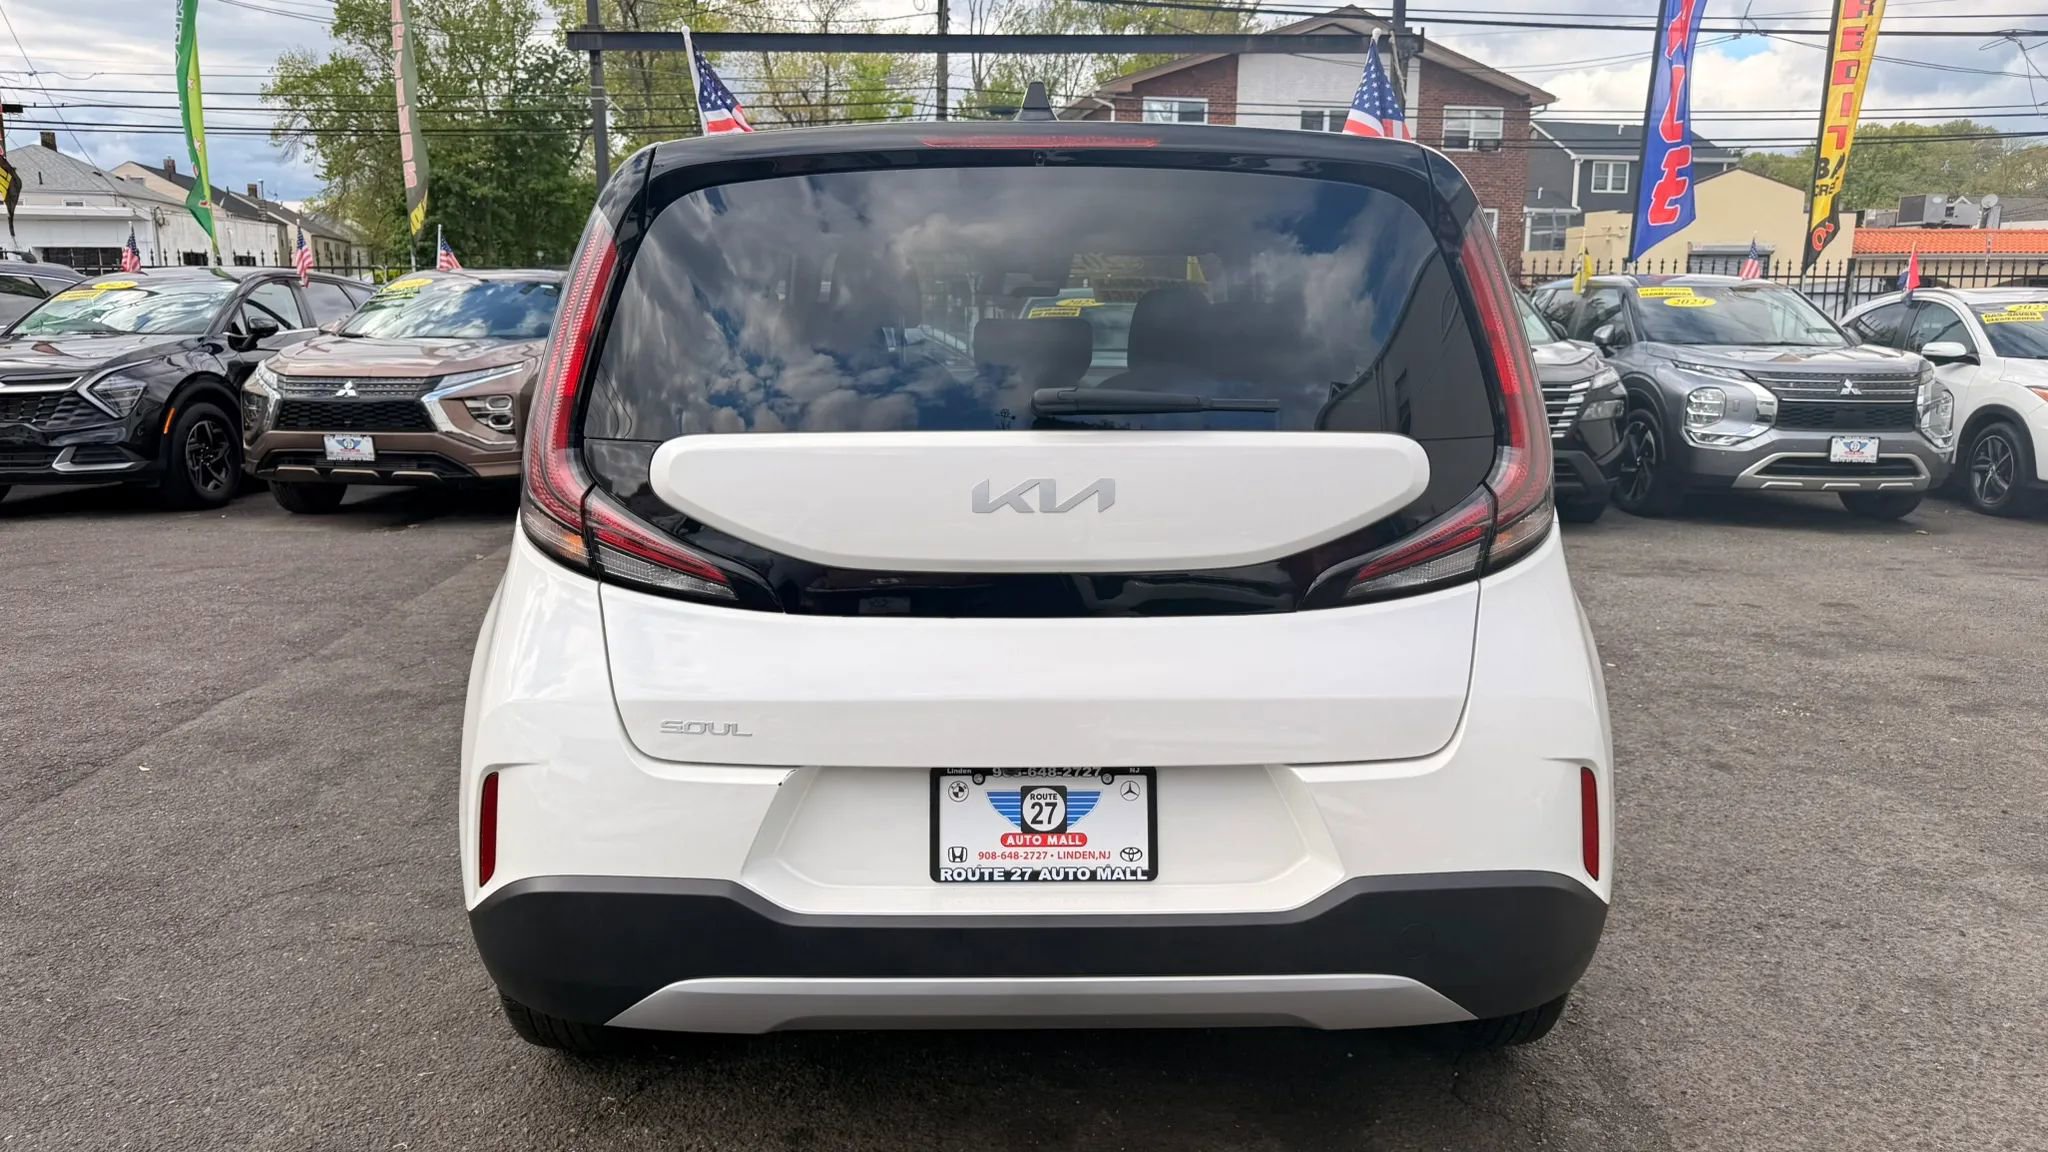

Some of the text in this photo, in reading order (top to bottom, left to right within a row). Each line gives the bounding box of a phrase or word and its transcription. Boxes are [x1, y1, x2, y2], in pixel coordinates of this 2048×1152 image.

[971, 478, 1116, 513] KIA
[660, 720, 753, 737] SOUL
[1030, 793, 1057, 801] ROUTE
[1030, 802, 1058, 825] 27
[1006, 834, 1082, 846] AUTO MALL
[978, 850, 1111, 861] 908-648-2727 LINDEN,NJ
[940, 866, 1148, 882] ROUTE 27 AUTO MALL
